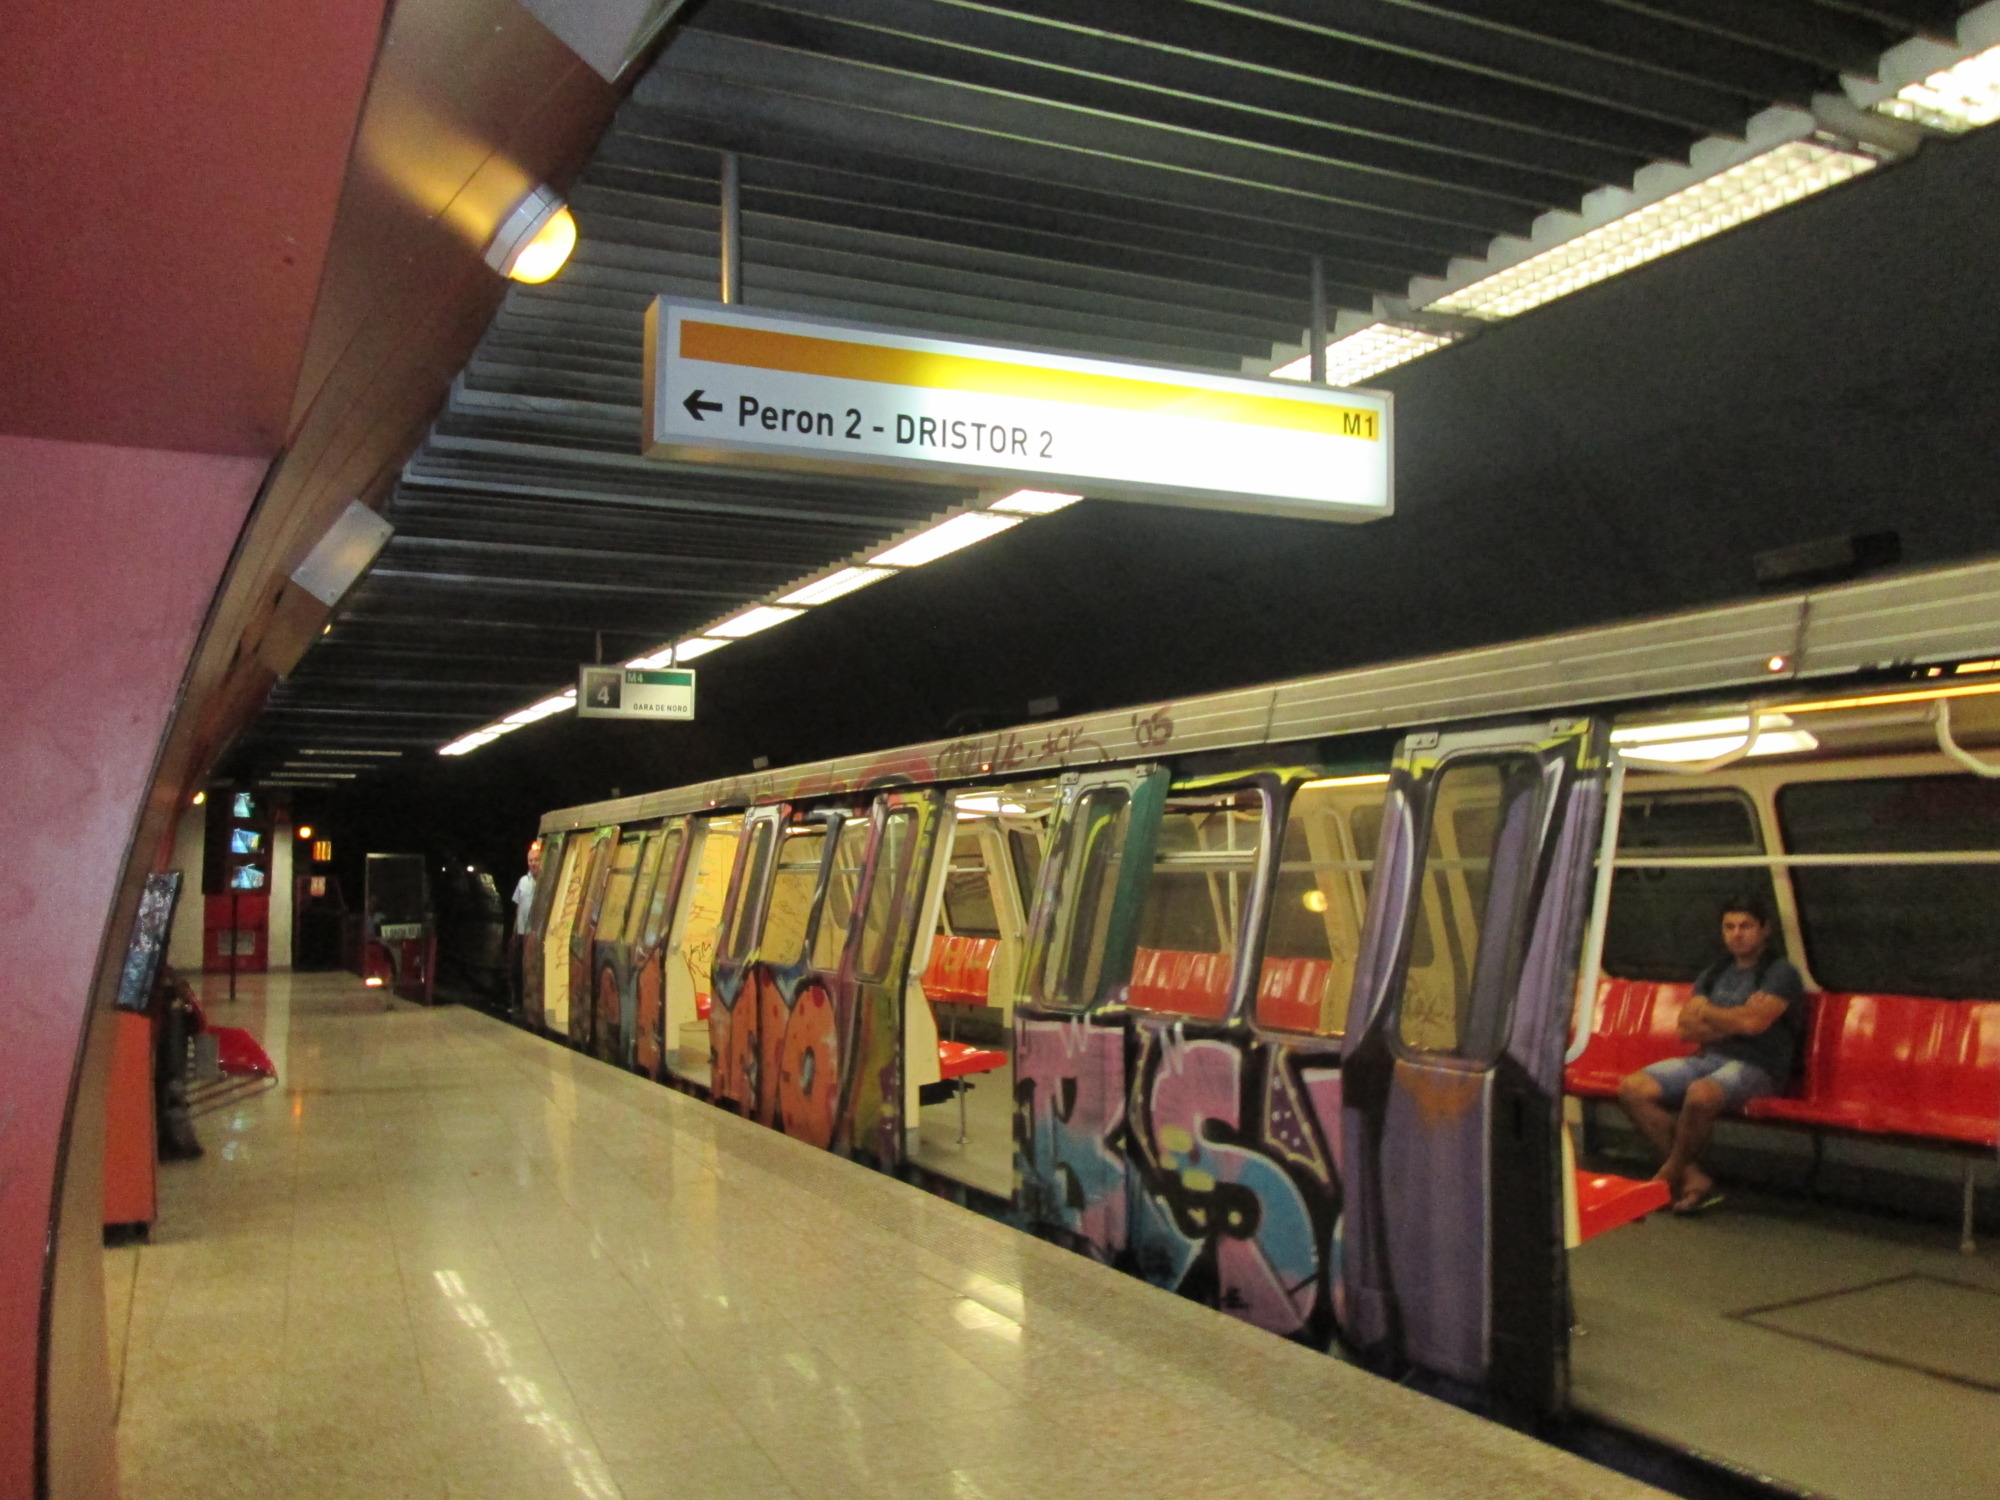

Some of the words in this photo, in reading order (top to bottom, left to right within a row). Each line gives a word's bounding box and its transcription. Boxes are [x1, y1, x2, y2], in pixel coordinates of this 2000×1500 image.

[738, 395, 834, 436] Peron
[845, 408, 862, 441] 2
[896, 413, 1029, 456] DRISTOR
[1039, 430, 1053, 459] 2
[1343, 412, 1373, 437] M1
[627, 673, 644, 684] M4
[597, 686, 610, 705] 4
[633, 703, 654, 711] GARA
[655, 703, 665, 712] DE
[666, 704, 688, 713] NORD
